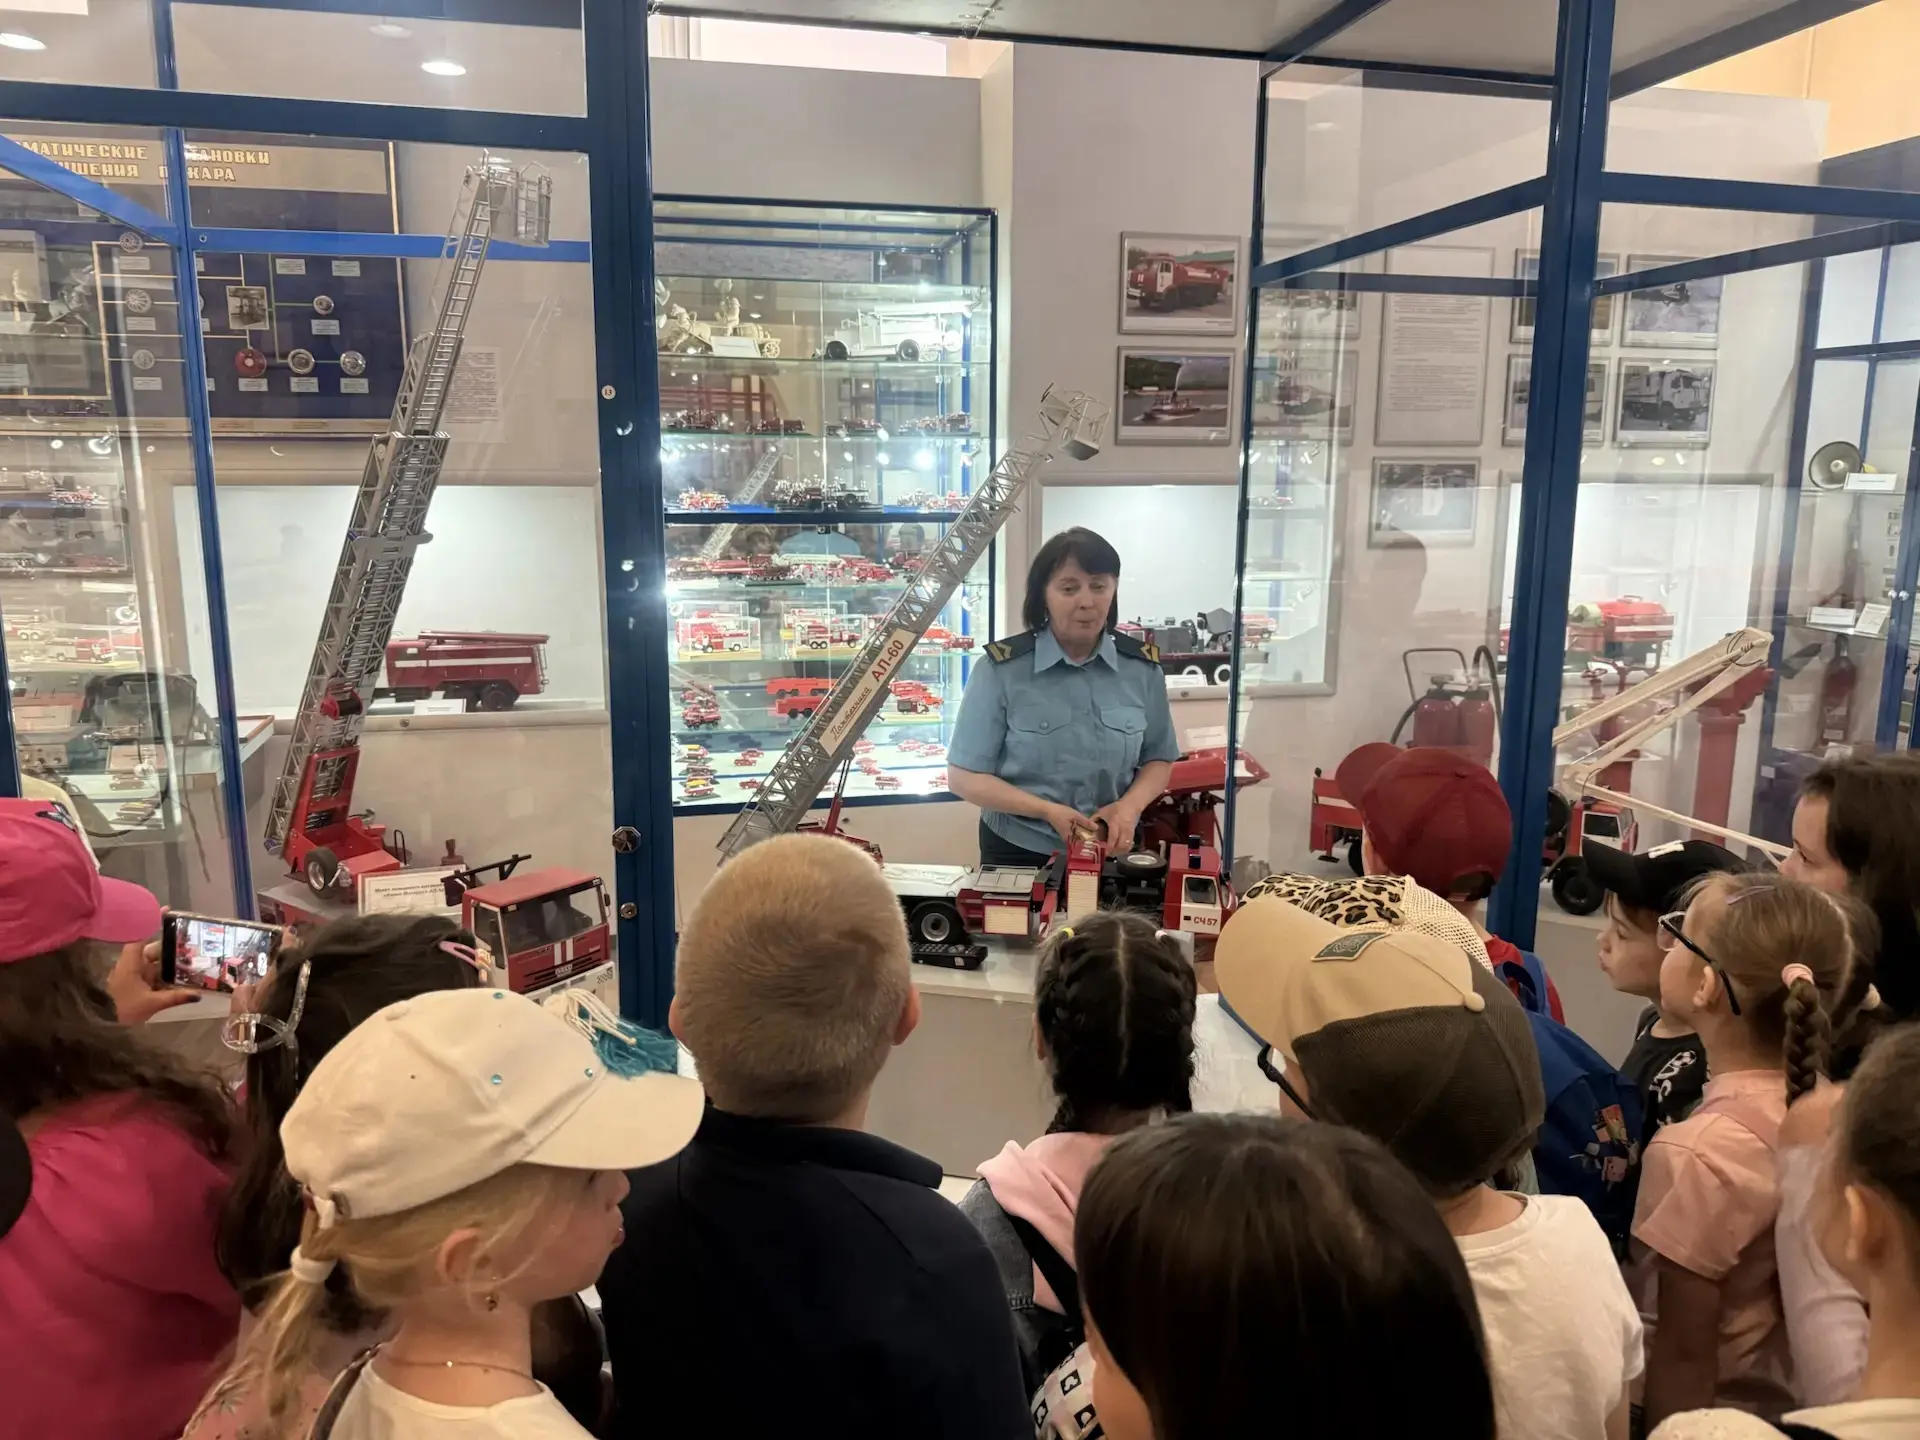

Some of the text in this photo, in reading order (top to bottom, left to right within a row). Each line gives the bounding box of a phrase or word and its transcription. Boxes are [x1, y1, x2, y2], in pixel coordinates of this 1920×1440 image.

[20, 140, 149, 160] МАТИЧЕСКИЕ
[159, 165, 235, 181] ПЖАРА
[871, 639, 904, 682] АЛ-60
